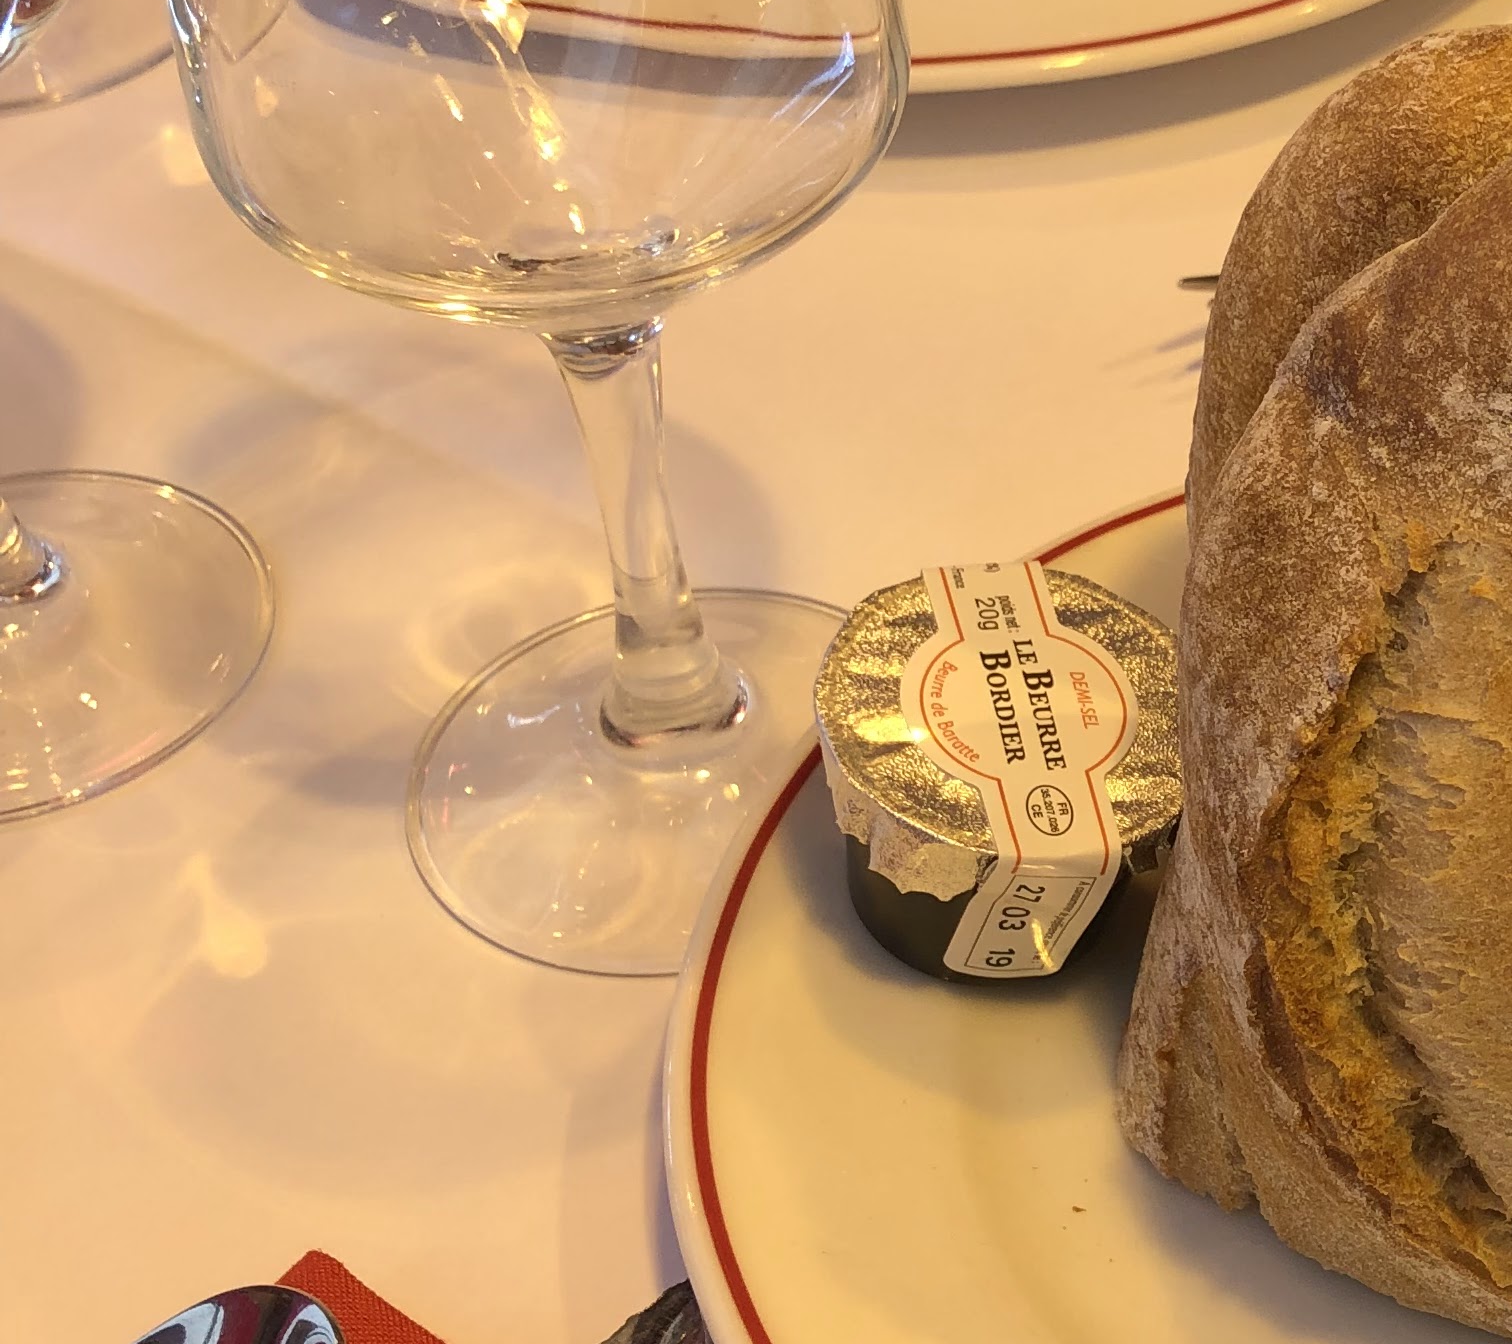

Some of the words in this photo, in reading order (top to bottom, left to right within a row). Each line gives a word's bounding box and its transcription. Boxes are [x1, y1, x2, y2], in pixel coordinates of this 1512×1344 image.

[974, 596, 1000, 632] 20g
[1012, 638, 1039, 666] LE
[930, 660, 959, 699] Beurre
[930, 703, 949, 718] de
[978, 649, 1027, 765] BORDIER
[1068, 671, 1100, 731] DEMI-SEL
[1021, 668, 1068, 772] BEURRE
[937, 720, 980, 764] Baratte
[1030, 803, 1045, 819] CE
[1056, 801, 1070, 817] FR
[1012, 884, 1046, 904] 27
[998, 906, 1031, 931] 03
[985, 948, 1016, 968] 19
